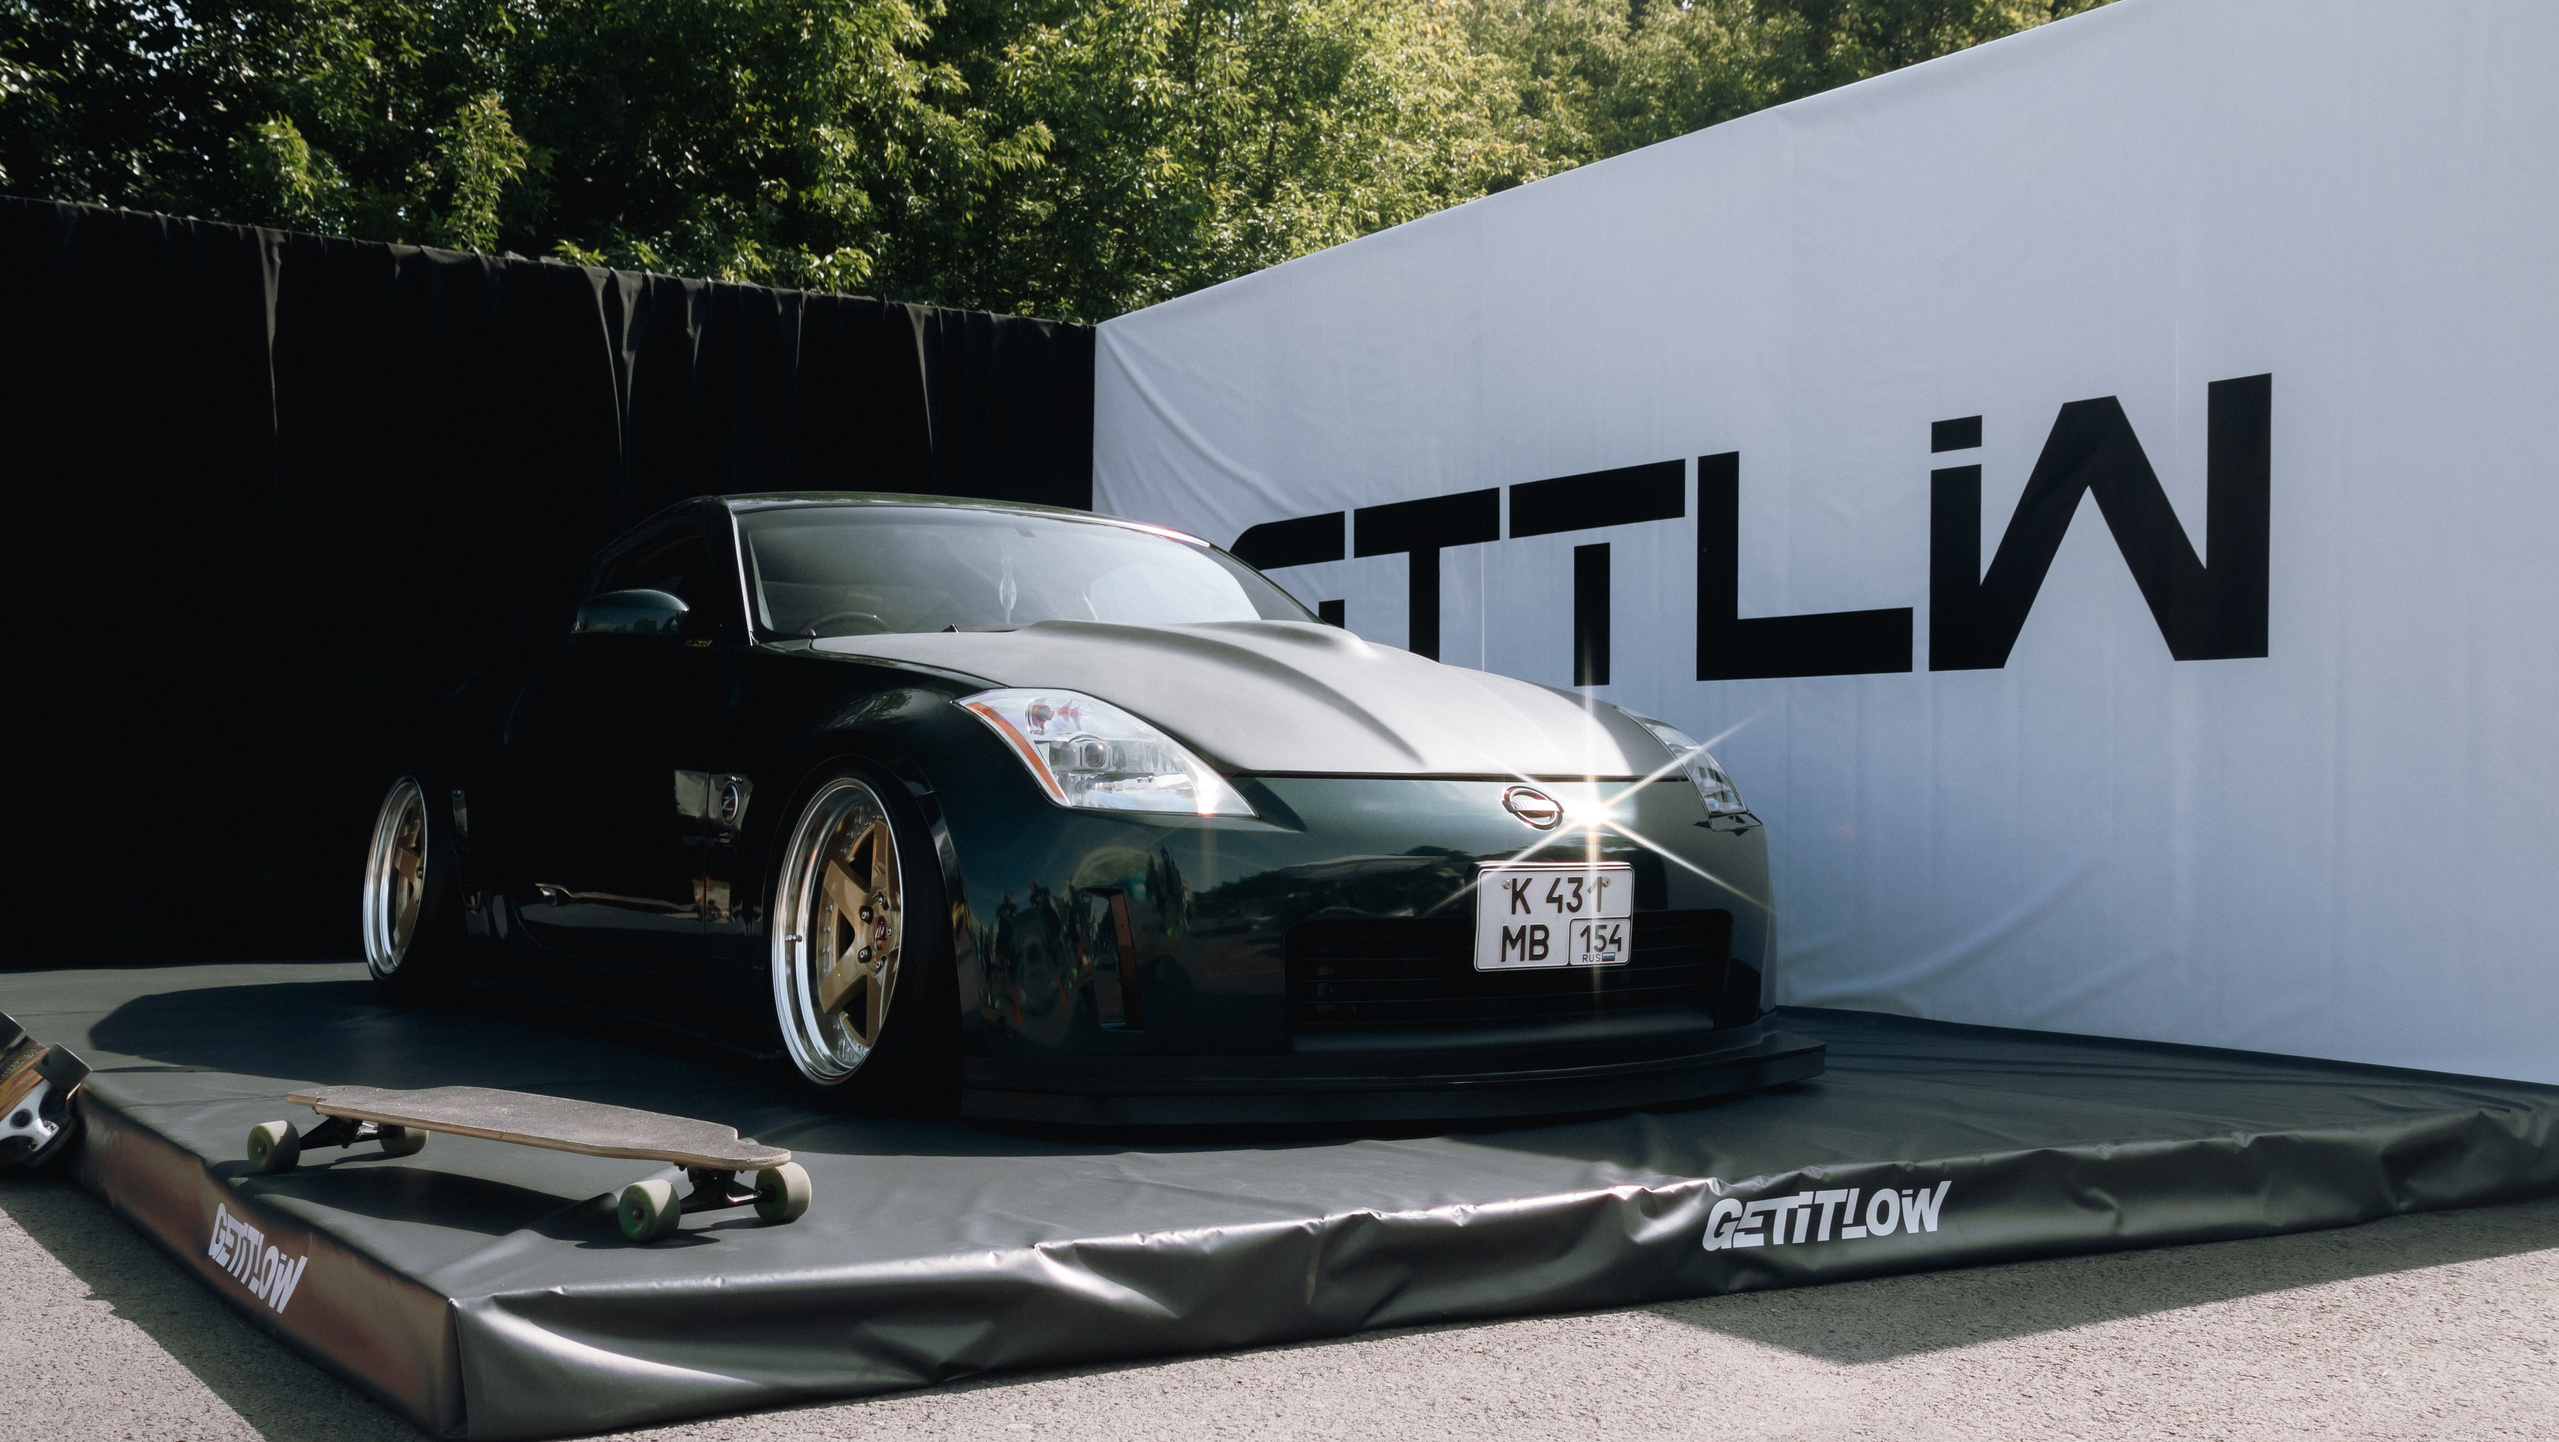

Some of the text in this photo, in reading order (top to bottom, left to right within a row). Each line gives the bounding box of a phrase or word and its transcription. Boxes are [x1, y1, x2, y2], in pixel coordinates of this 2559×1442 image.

[1511, 877, 1602, 914] K 431
[1501, 924, 1622, 962] MB 154
[1582, 954, 1601, 962] RUS
